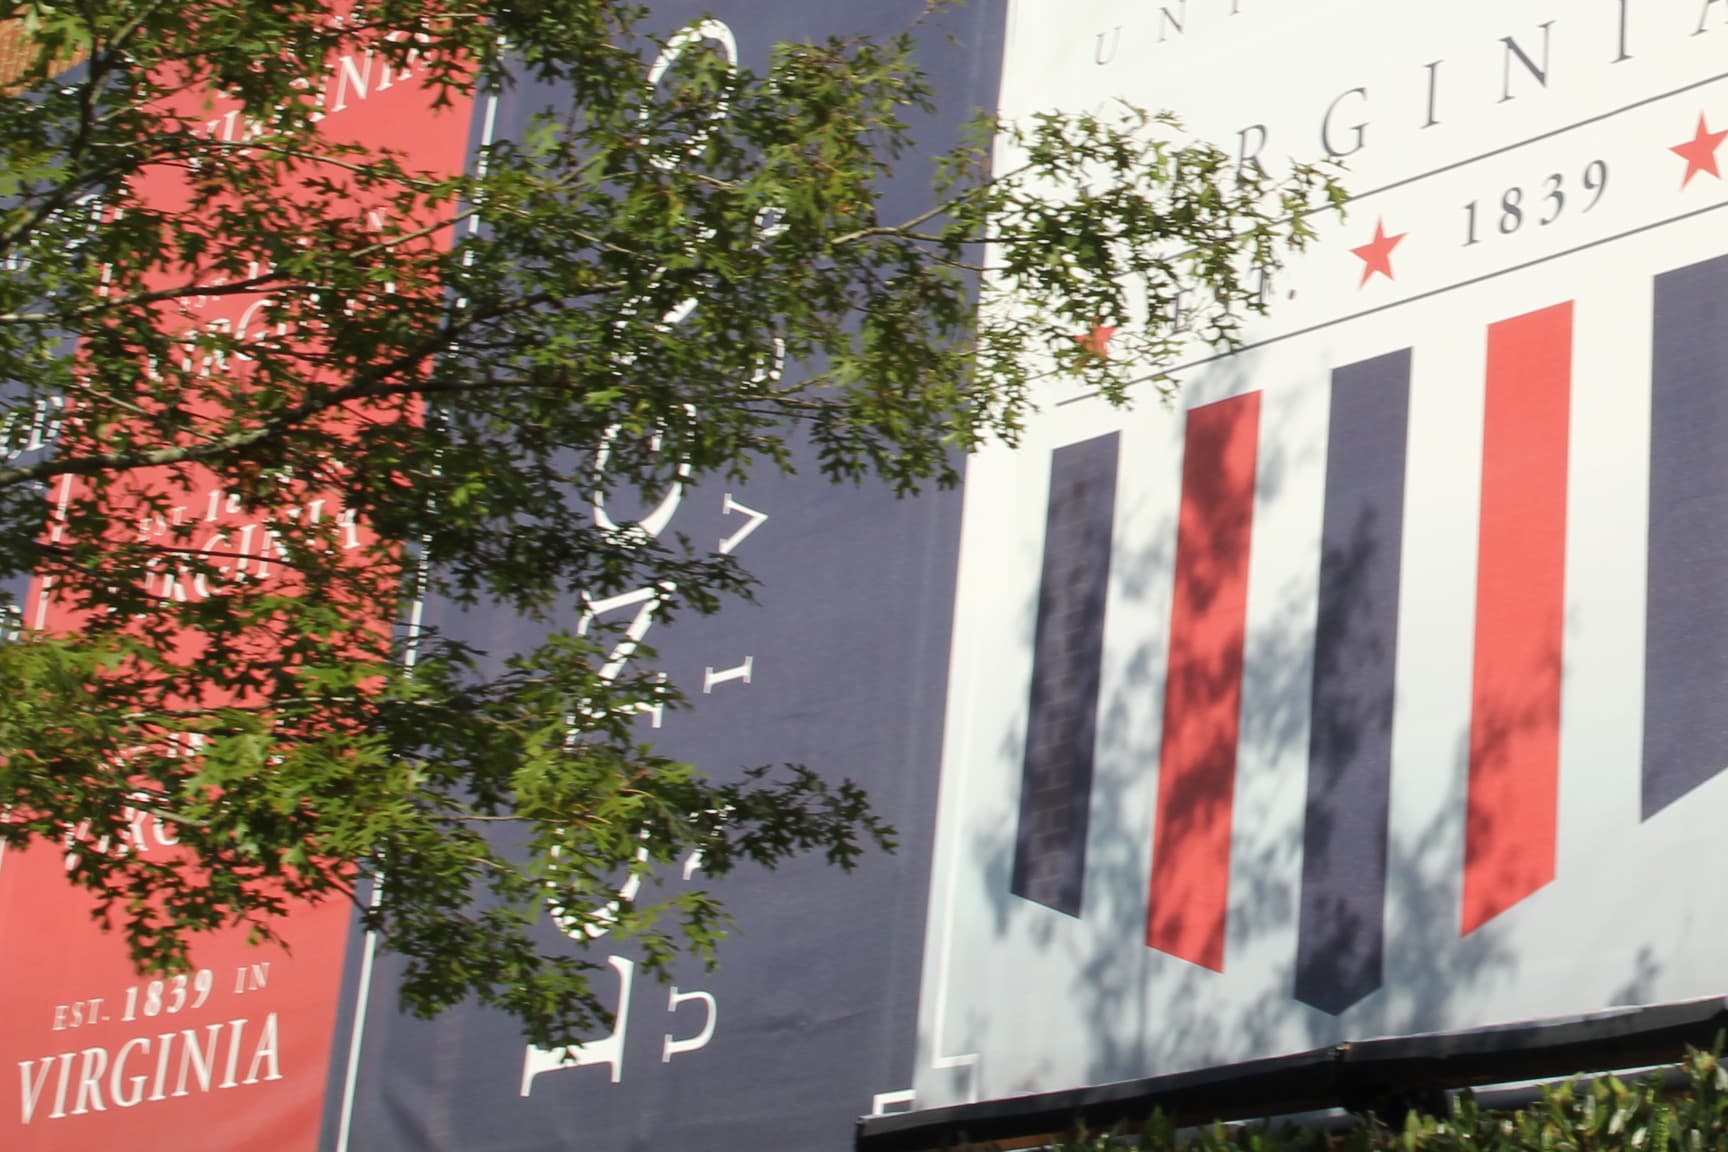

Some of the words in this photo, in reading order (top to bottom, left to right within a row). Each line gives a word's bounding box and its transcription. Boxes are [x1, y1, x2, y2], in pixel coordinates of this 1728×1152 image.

[1460, 159, 1609, 247] 1839
[51, 997, 111, 1031] EST.
[120, 968, 214, 1022] 1839
[232, 961, 271, 994] IN
[16, 1011, 284, 1126] VIRGINIA
